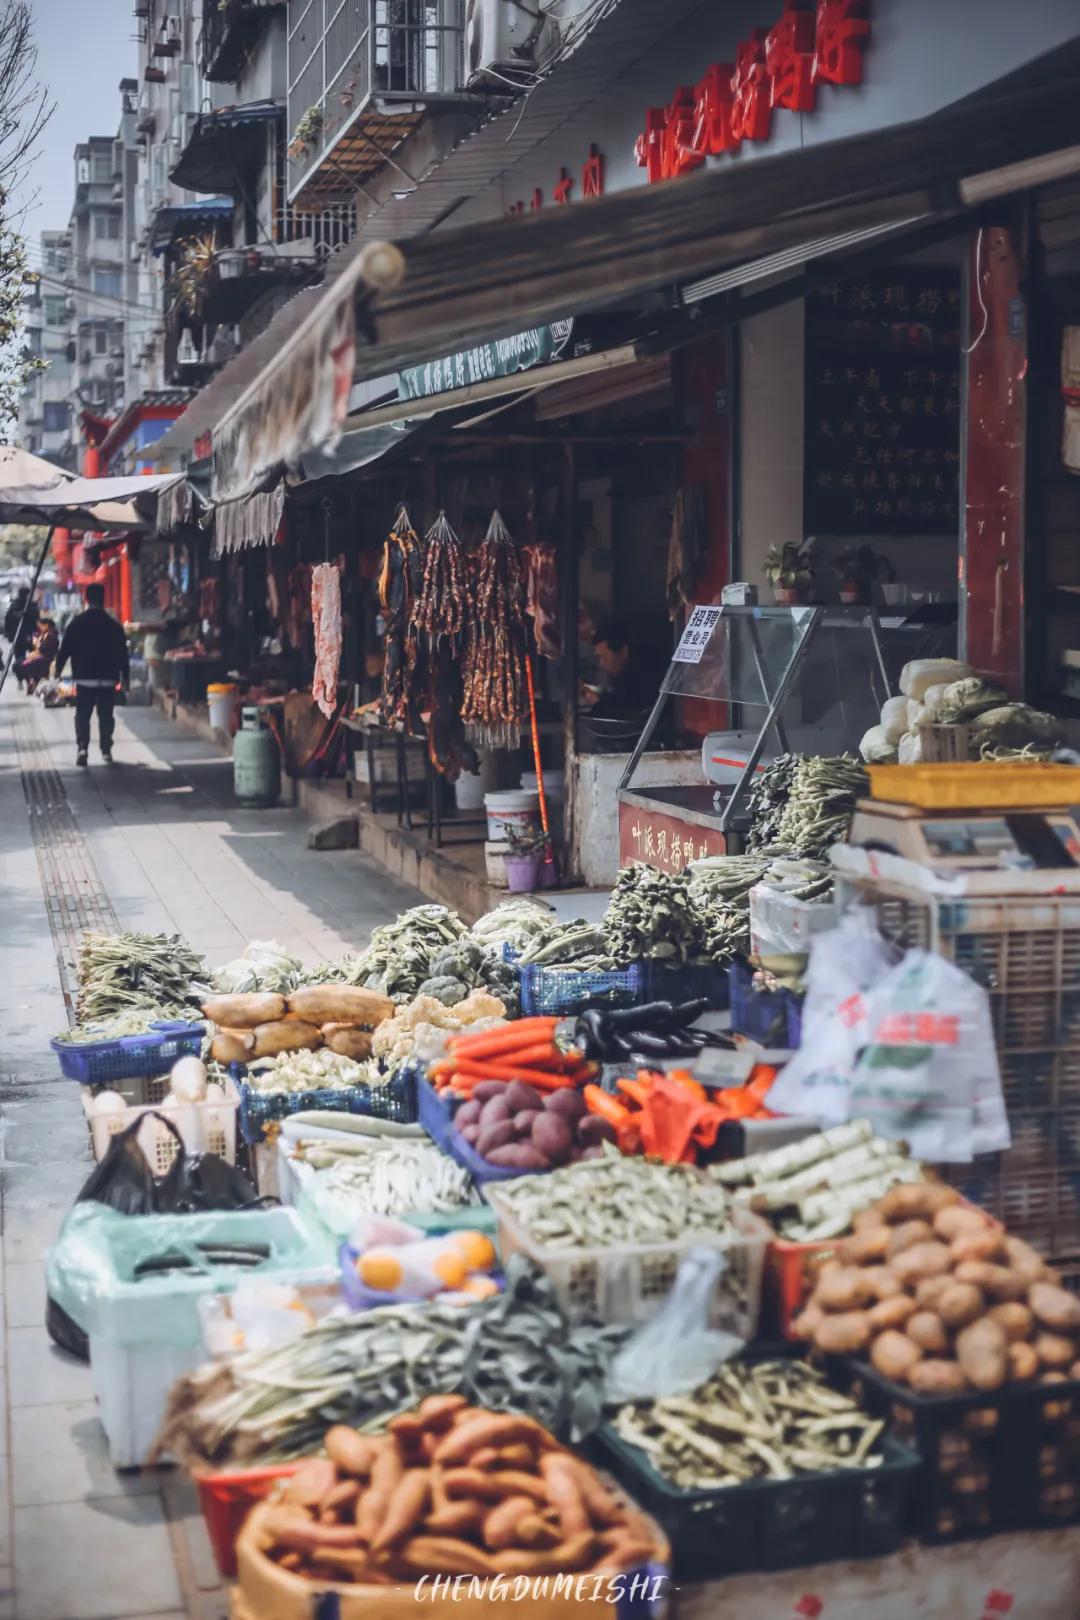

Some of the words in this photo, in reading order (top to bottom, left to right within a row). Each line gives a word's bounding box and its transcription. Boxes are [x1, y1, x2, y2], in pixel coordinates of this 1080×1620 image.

[690, 609, 720, 627] 招聘
[683, 630, 709, 645] 营业员
